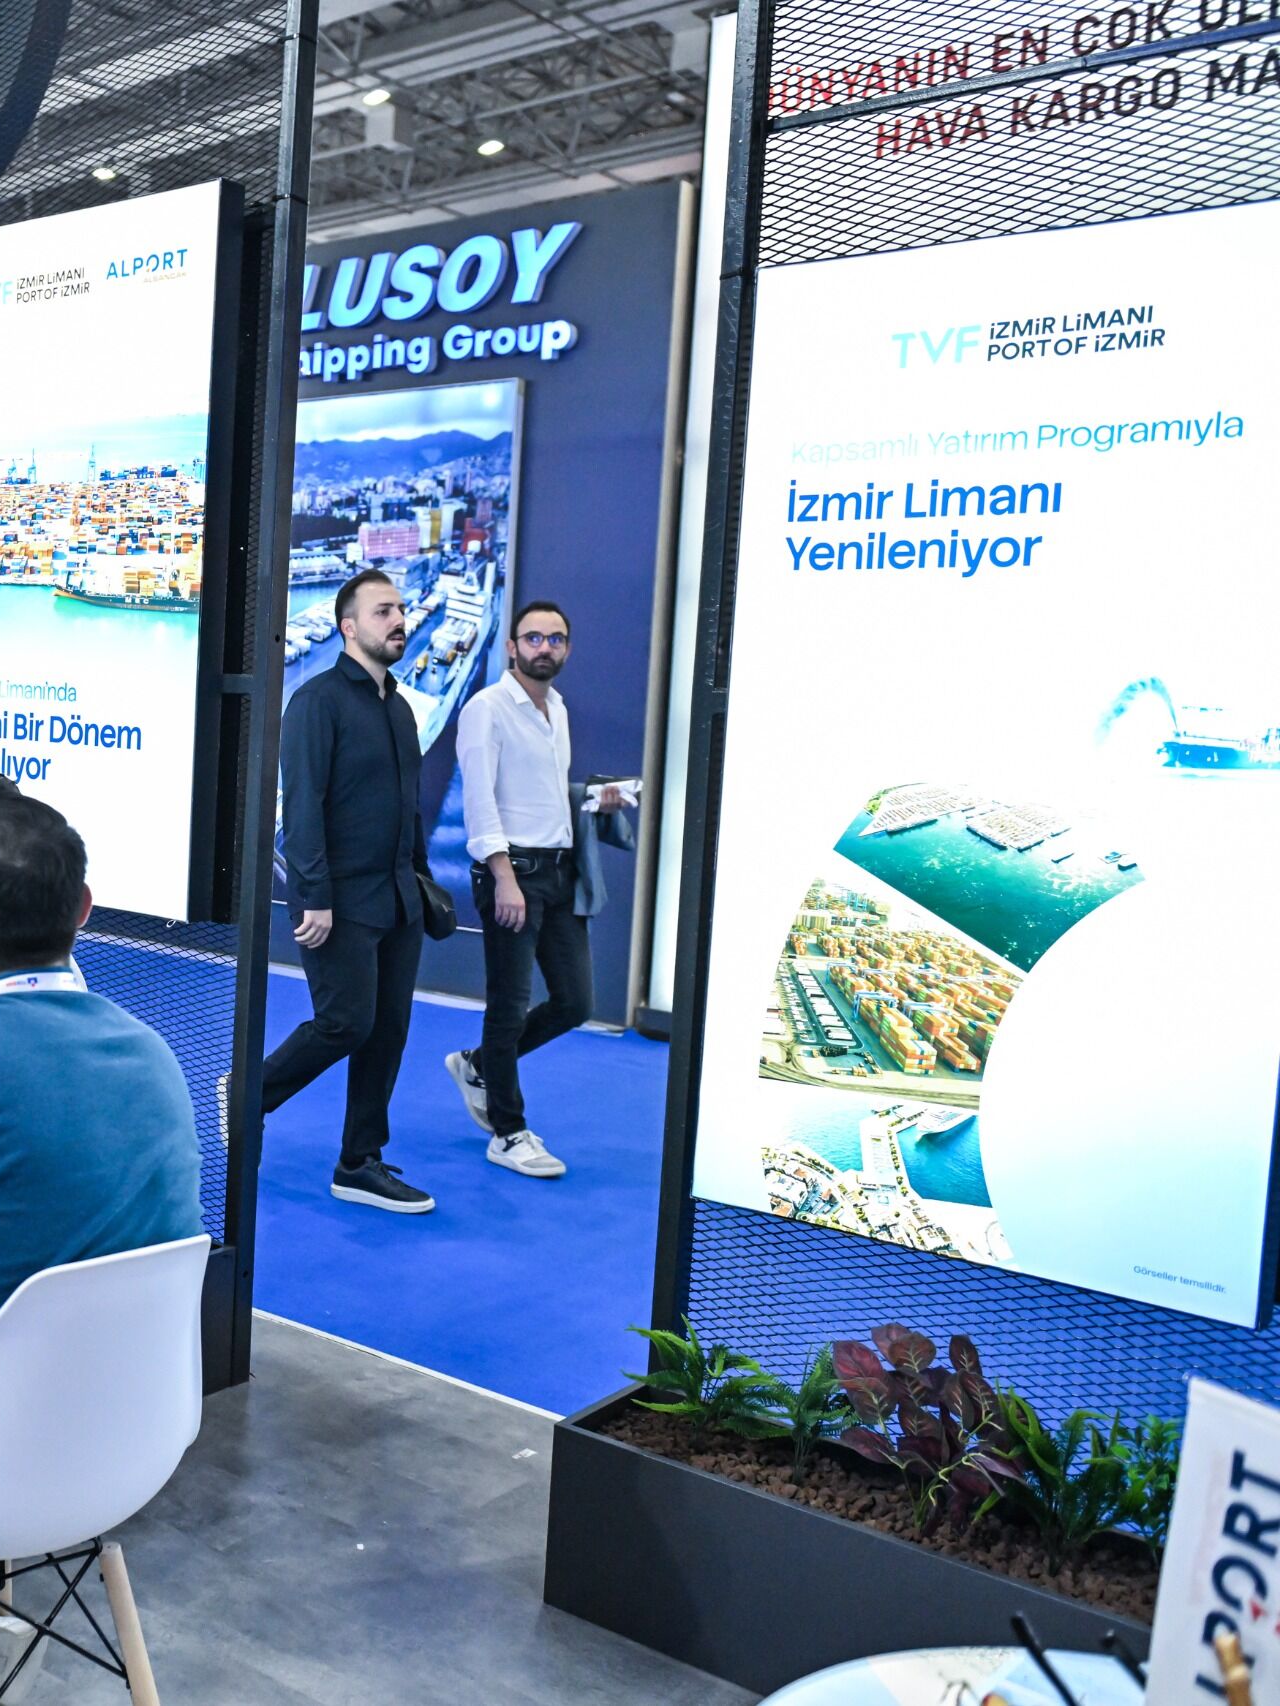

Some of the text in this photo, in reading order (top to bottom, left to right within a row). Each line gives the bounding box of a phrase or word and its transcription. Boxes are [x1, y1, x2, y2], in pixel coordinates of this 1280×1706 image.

[992, 24, 1049, 73] EN
[876, 104, 988, 158] HAVA
[1011, 68, 1180, 135] KARGO
[106, 249, 188, 280] ALPORT
[442, 319, 576, 361] Group
[891, 324, 982, 369] TVF
[987, 339, 1051, 361] PORT
[1053, 335, 1087, 357] OF
[927, 426, 1029, 456] Yatırım
[1036, 410, 1245, 453] Programıyla
[787, 478, 1063, 523] İzmir Limanı
[785, 529, 1043, 578] Yenileniyor
[13, 712, 44, 742] Bir
[49, 714, 142, 750] Dönem
[1133, 1265, 1177, 1282] Görseller
